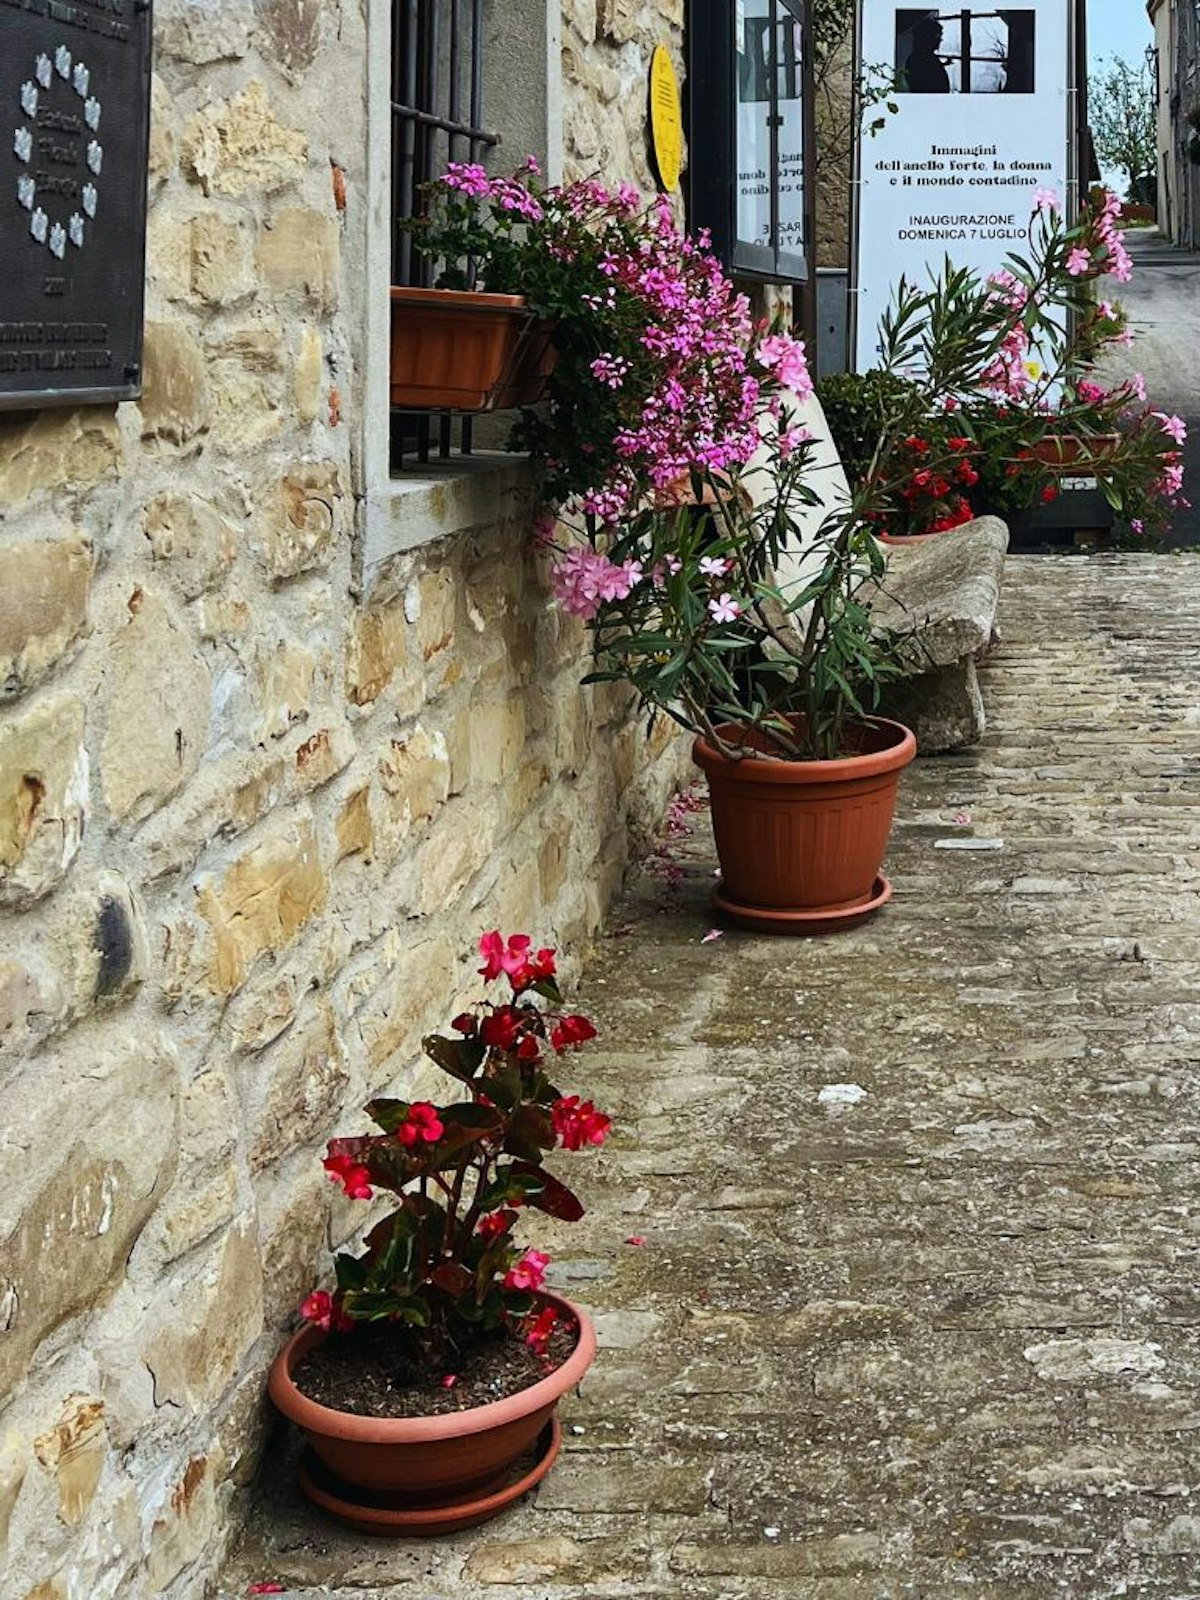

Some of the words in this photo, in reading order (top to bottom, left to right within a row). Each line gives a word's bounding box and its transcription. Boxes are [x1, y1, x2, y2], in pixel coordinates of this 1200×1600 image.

[931, 144, 997, 157] Immagini
[993, 160, 1005, 171] la
[1009, 160, 1052, 171] donna
[889, 176, 898, 186] e
[902, 175, 912, 186] il
[916, 175, 965, 186] mondo
[968, 175, 1038, 186] contadino
[909, 215, 1016, 226] INAUGURAZIONE
[898, 229, 967, 240] DOMENICA
[970, 229, 977, 240] 7
[980, 228, 1027, 240] LUGLIO
